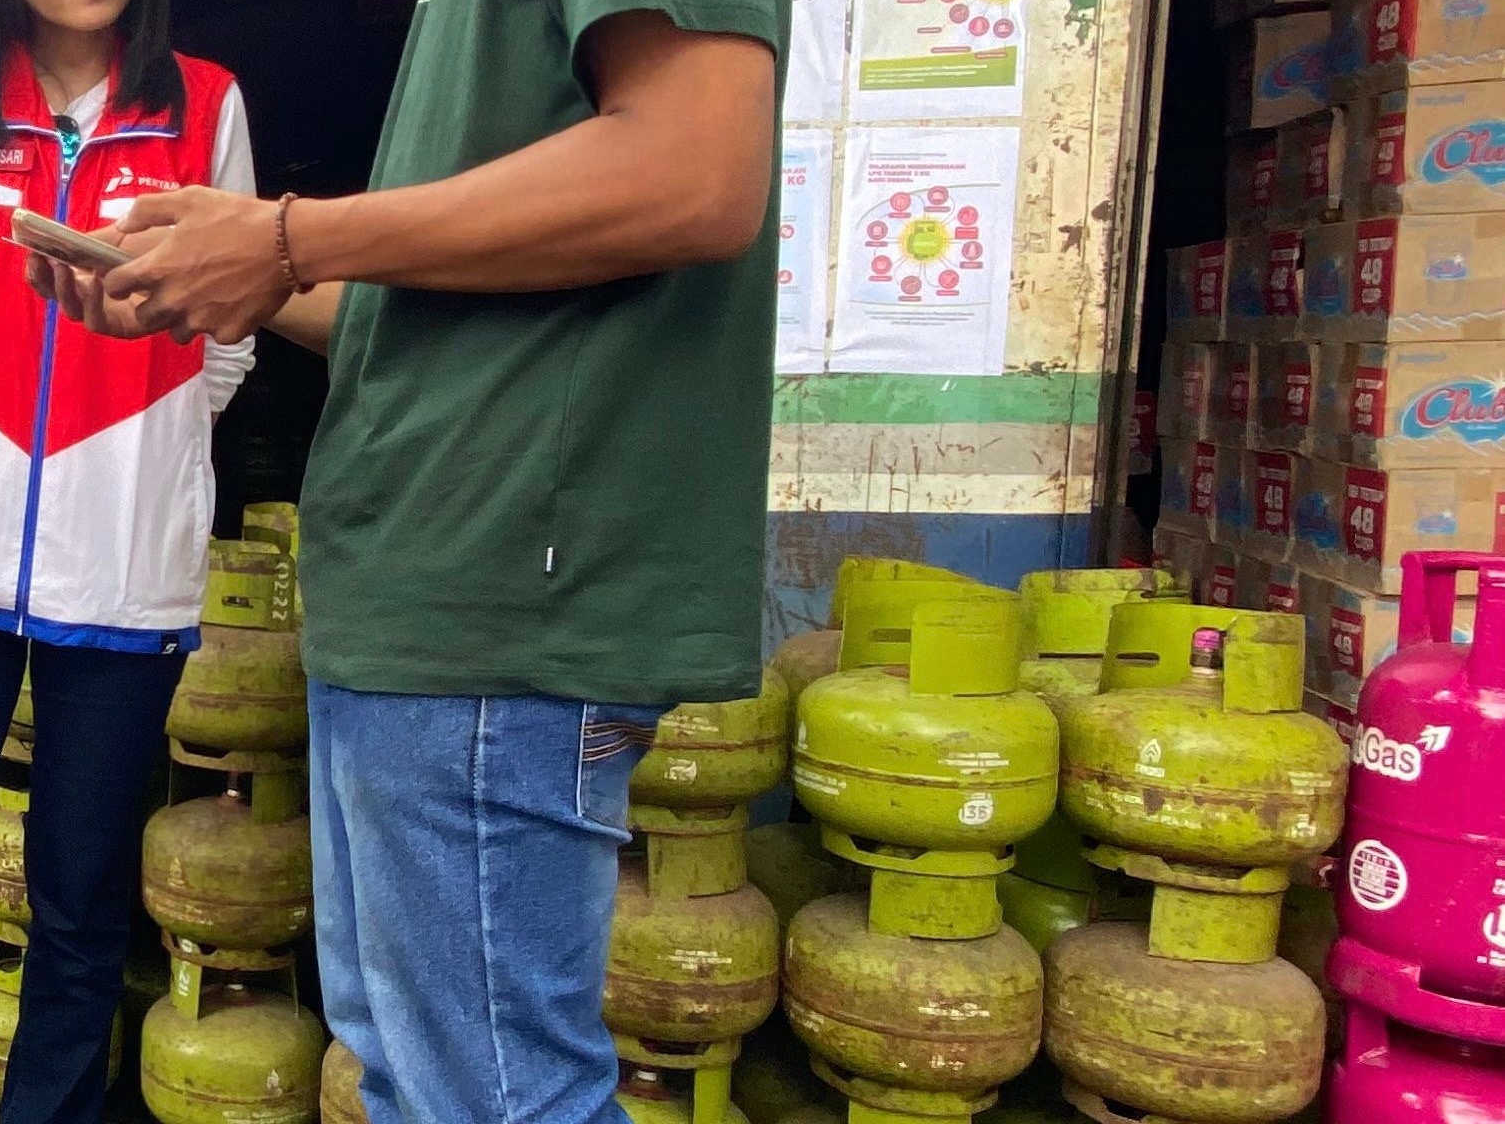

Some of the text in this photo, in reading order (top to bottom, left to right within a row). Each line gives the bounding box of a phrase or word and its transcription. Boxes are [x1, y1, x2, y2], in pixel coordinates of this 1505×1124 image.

[1434, 128, 1505, 172] Clu
[137, 176, 181, 192] PERTAM
[1361, 257, 1383, 285] 48
[1263, 484, 1284, 510] 48
[1350, 504, 1375, 535] 48
[1362, 730, 1417, 776] Gas
